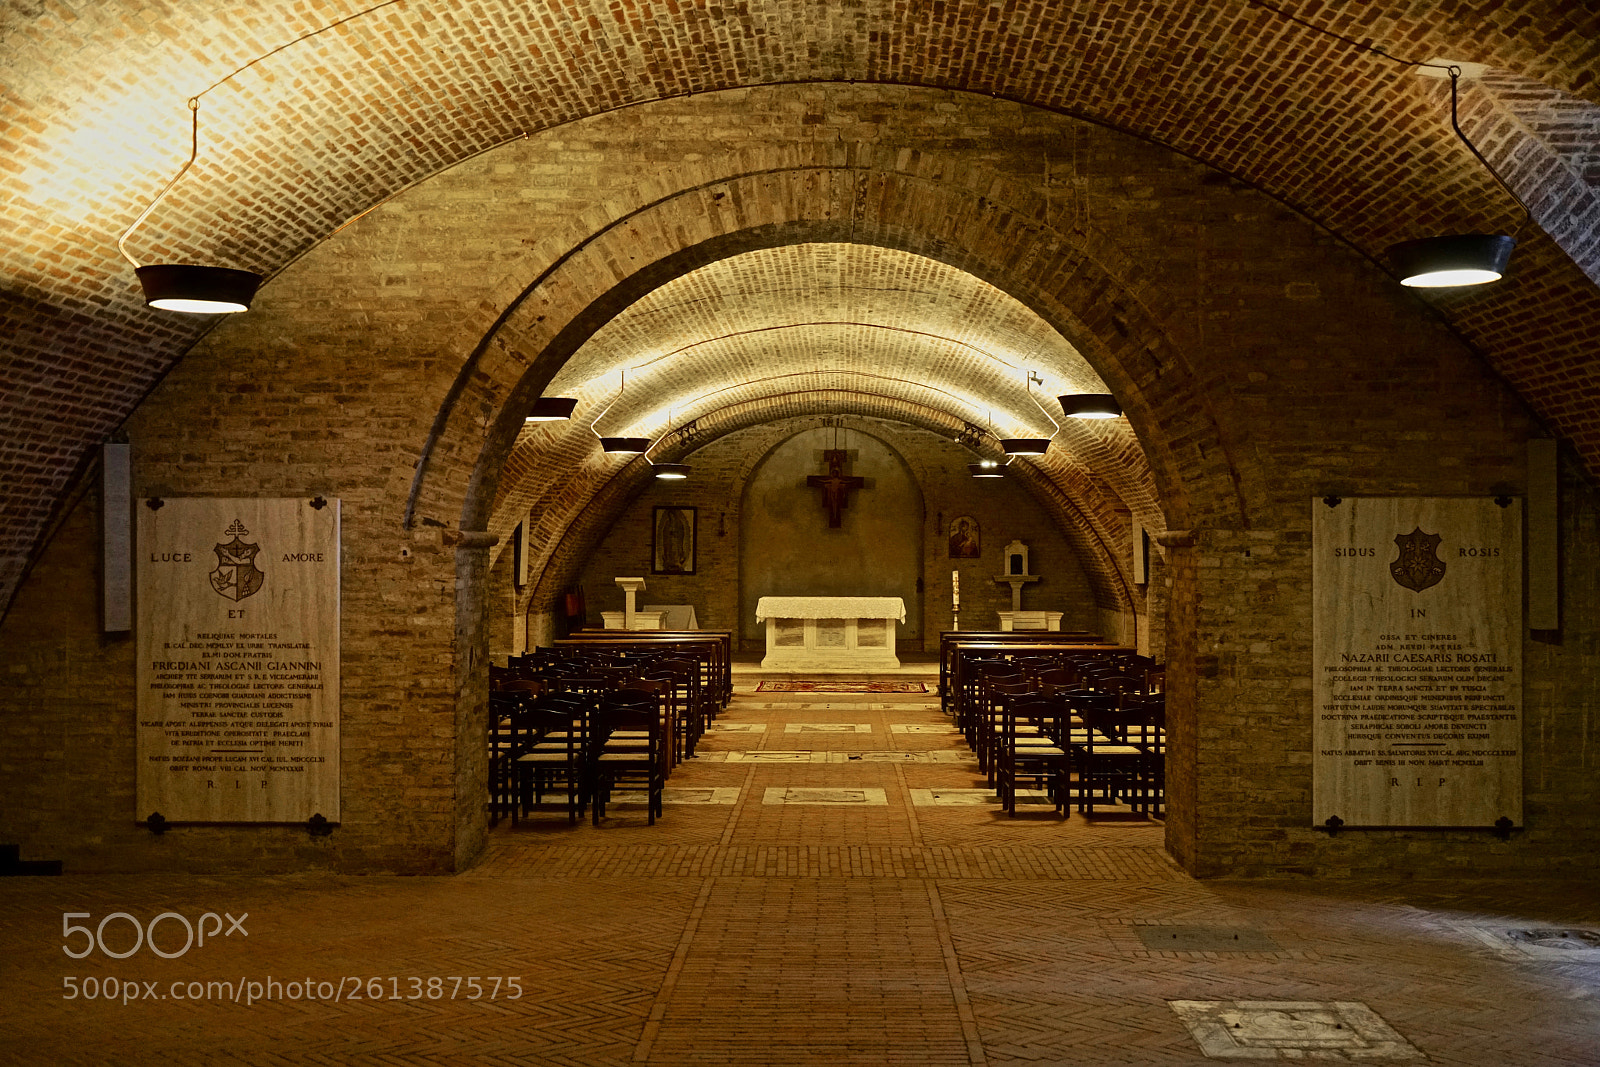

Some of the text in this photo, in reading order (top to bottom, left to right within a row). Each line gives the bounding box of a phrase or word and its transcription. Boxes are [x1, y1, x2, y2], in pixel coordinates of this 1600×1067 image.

[1334, 548, 1376, 557] SIDUS
[1459, 548, 1500, 557] ROSIS
[151, 553, 192, 562] LUCE
[282, 553, 324, 562] AMORE
[228, 610, 245, 619] ET
[1410, 609, 1426, 618] IN
[1341, 653, 1496, 663] NAZARII CAESARIS ROSATI
[152, 661, 321, 671] FRIGDIANI ASCANII GIANNINI
[1417, 714, 1465, 722] SCRIPTISQUE
